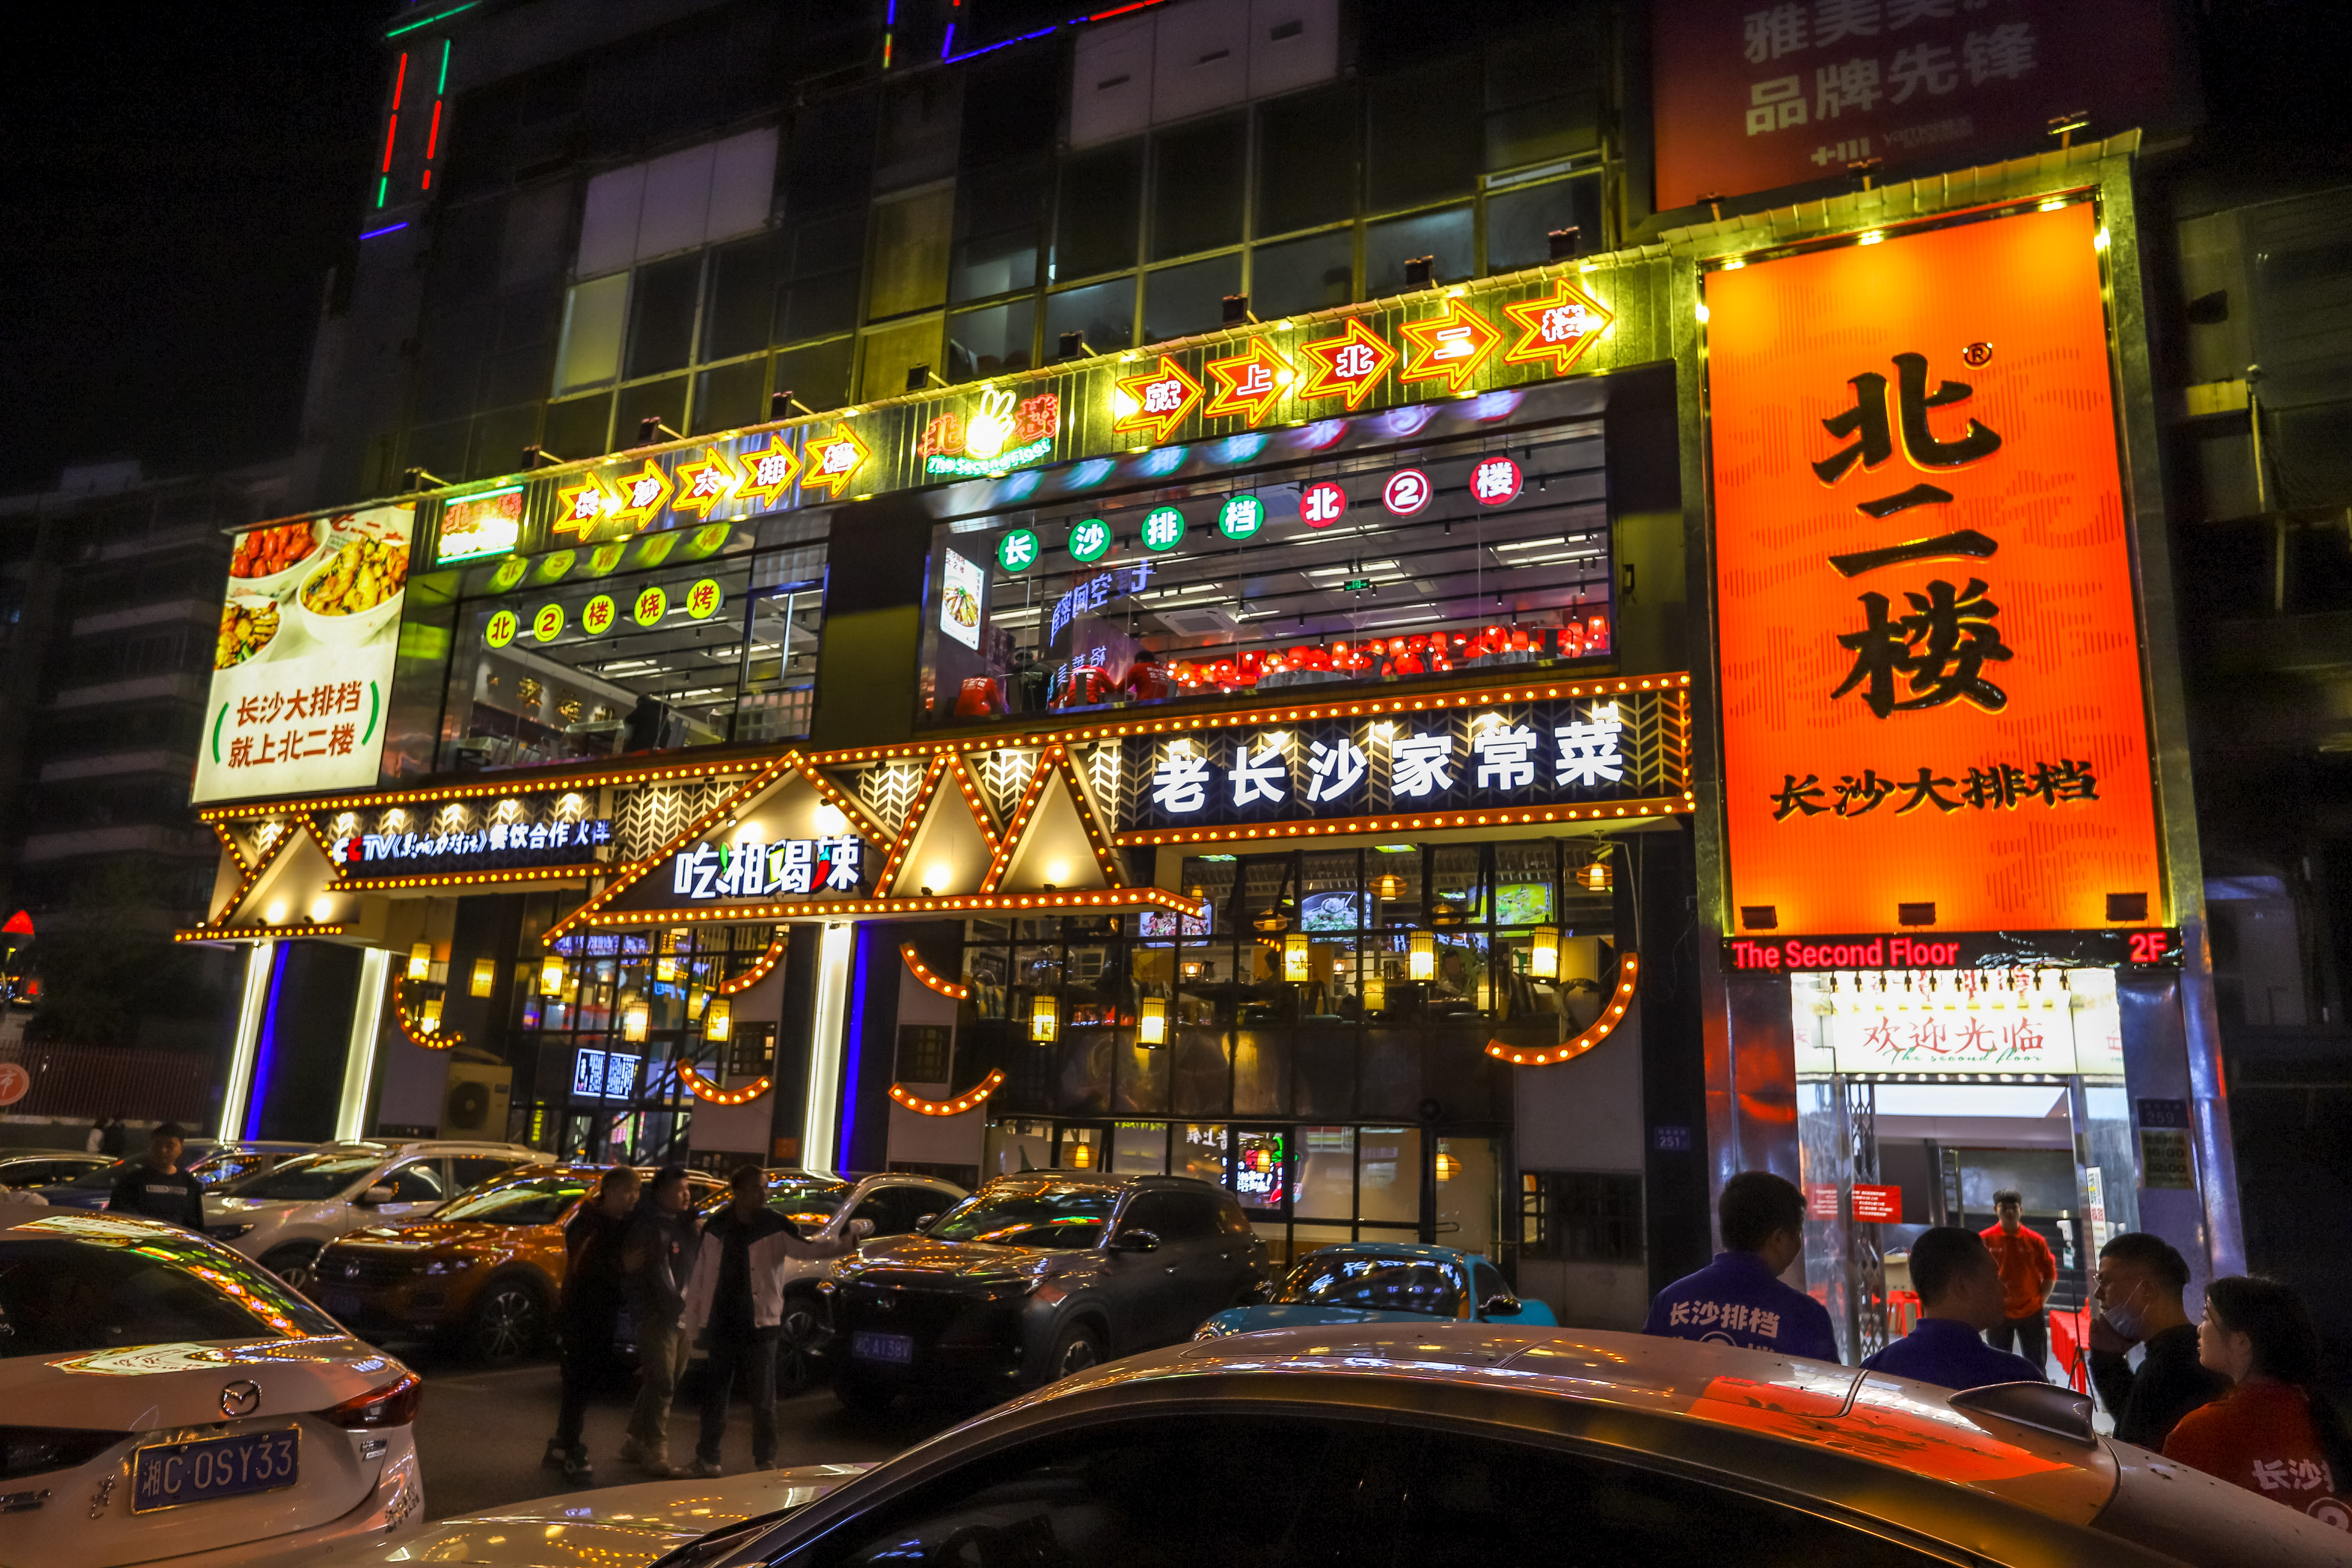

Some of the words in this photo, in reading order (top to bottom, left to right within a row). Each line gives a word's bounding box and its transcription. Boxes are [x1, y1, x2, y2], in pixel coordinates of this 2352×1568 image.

[1746, 22, 2035, 136] 品牌先锋
[1145, 305, 1586, 412] 就上北二楼
[576, 442, 858, 519] 长沙大排档
[926, 455, 957, 474] The
[954, 453, 1011, 476] Second
[1811, 352, 2013, 719] 北二楼
[492, 585, 714, 640] 北2楼烧烤
[237, 681, 362, 727] 长沙大排档
[228, 723, 355, 768] 就上北二楼
[1152, 718, 1624, 813] 老长沙家常菜
[1770, 759, 2101, 822] 长沙大排档
[1733, 942, 1781, 969] The
[1785, 938, 1883, 967] Second
[1889, 937, 1960, 967] Floor
[2130, 933, 2167, 962] 2F
[1863, 1016, 2043, 1053] 欢迎光临
[1883, 1047, 1922, 1065] The
[1930, 1047, 1988, 1063] second
[1995, 1047, 2042, 1064] floor
[1660, 1136, 1680, 1147] 251
[1670, 1300, 1780, 1338] 长沙排档
